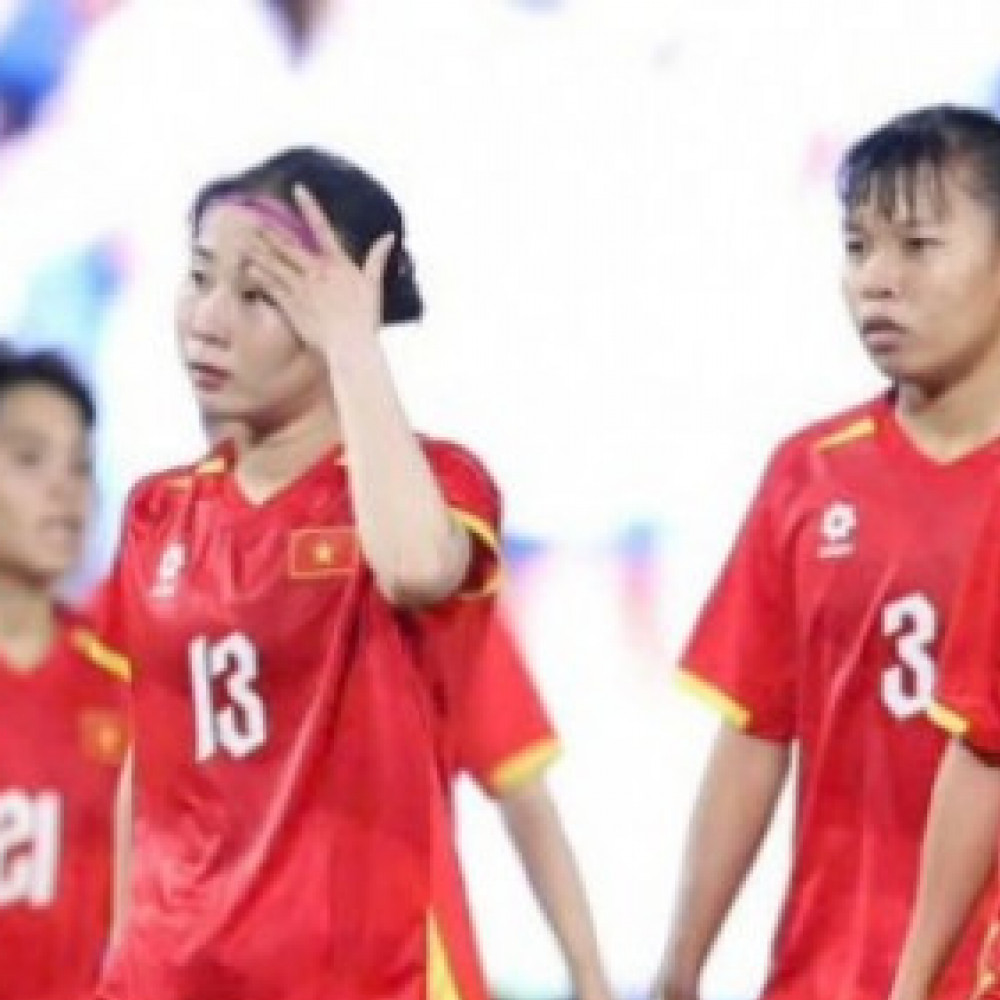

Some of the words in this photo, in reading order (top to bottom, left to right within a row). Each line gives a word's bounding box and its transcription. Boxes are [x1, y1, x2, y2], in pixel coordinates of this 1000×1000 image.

[188, 632, 267, 761] 13
[880, 593, 938, 719] 3
[0, 788, 60, 906] 21
